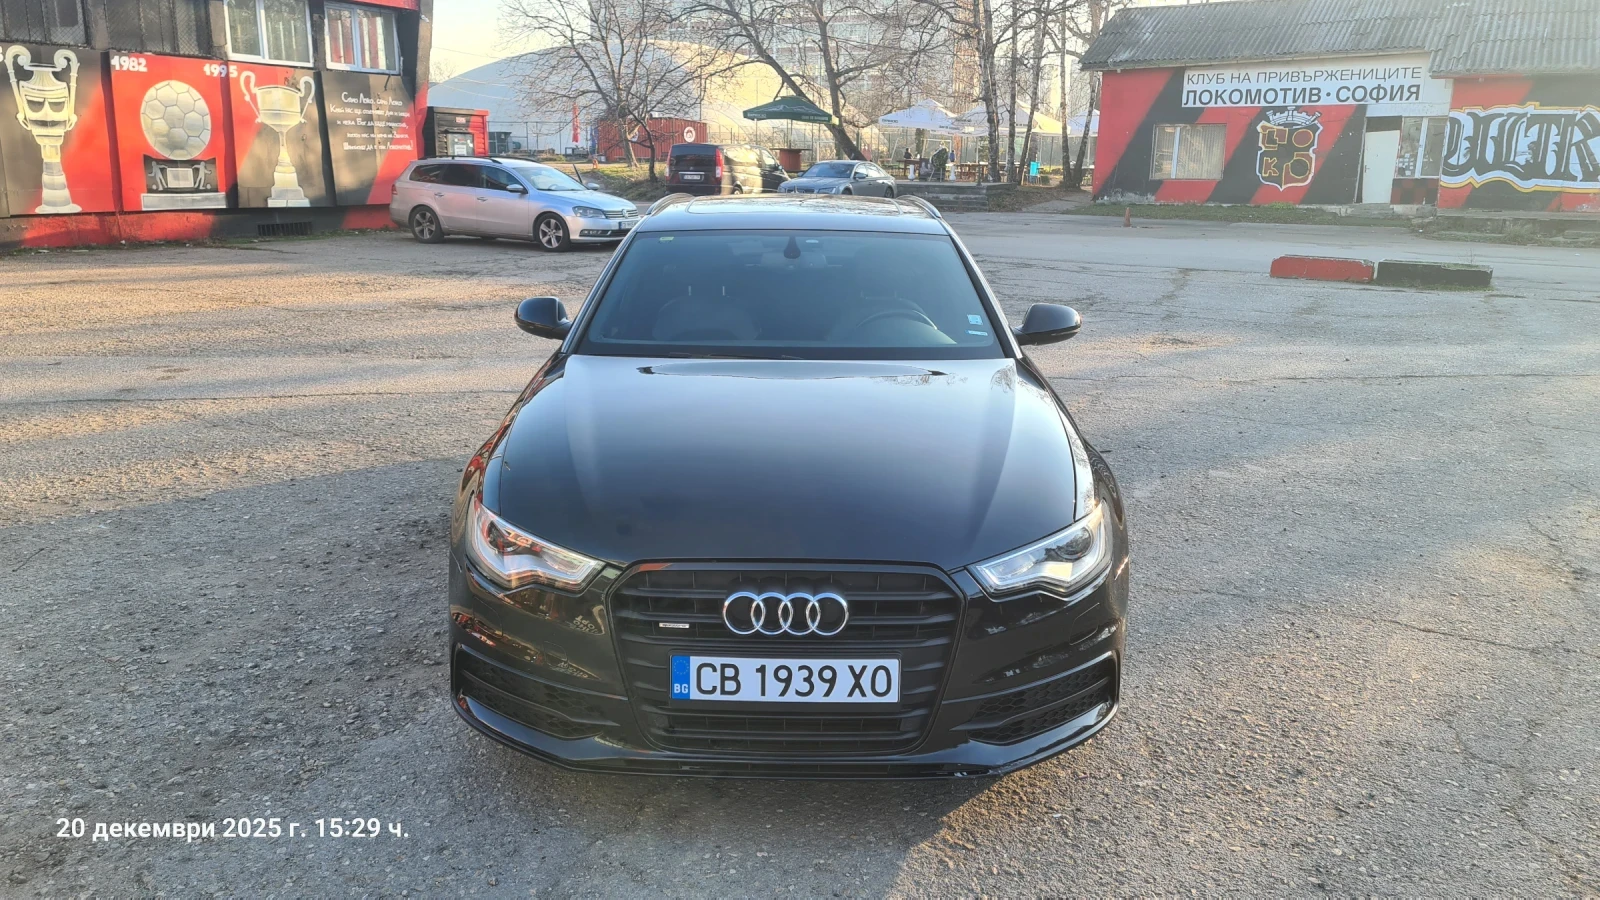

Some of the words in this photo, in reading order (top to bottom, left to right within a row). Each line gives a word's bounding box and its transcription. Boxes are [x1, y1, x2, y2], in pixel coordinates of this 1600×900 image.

[111, 55, 147, 72] 1982
[203, 63, 238, 78] 1995
[1187, 73, 1225, 85] КЛУБ
[1230, 72, 1252, 84] НА
[1256, 66, 1423, 84] ПРИВЪРЖЕНИЦИТЕ
[1184, 87, 1322, 106] ЛОКОМОТИВ
[1335, 84, 1421, 104] СОФИЯ
[673, 683, 689, 695] BG
[696, 662, 742, 697] CB
[755, 664, 838, 698] 1939
[847, 665, 893, 698] XO
